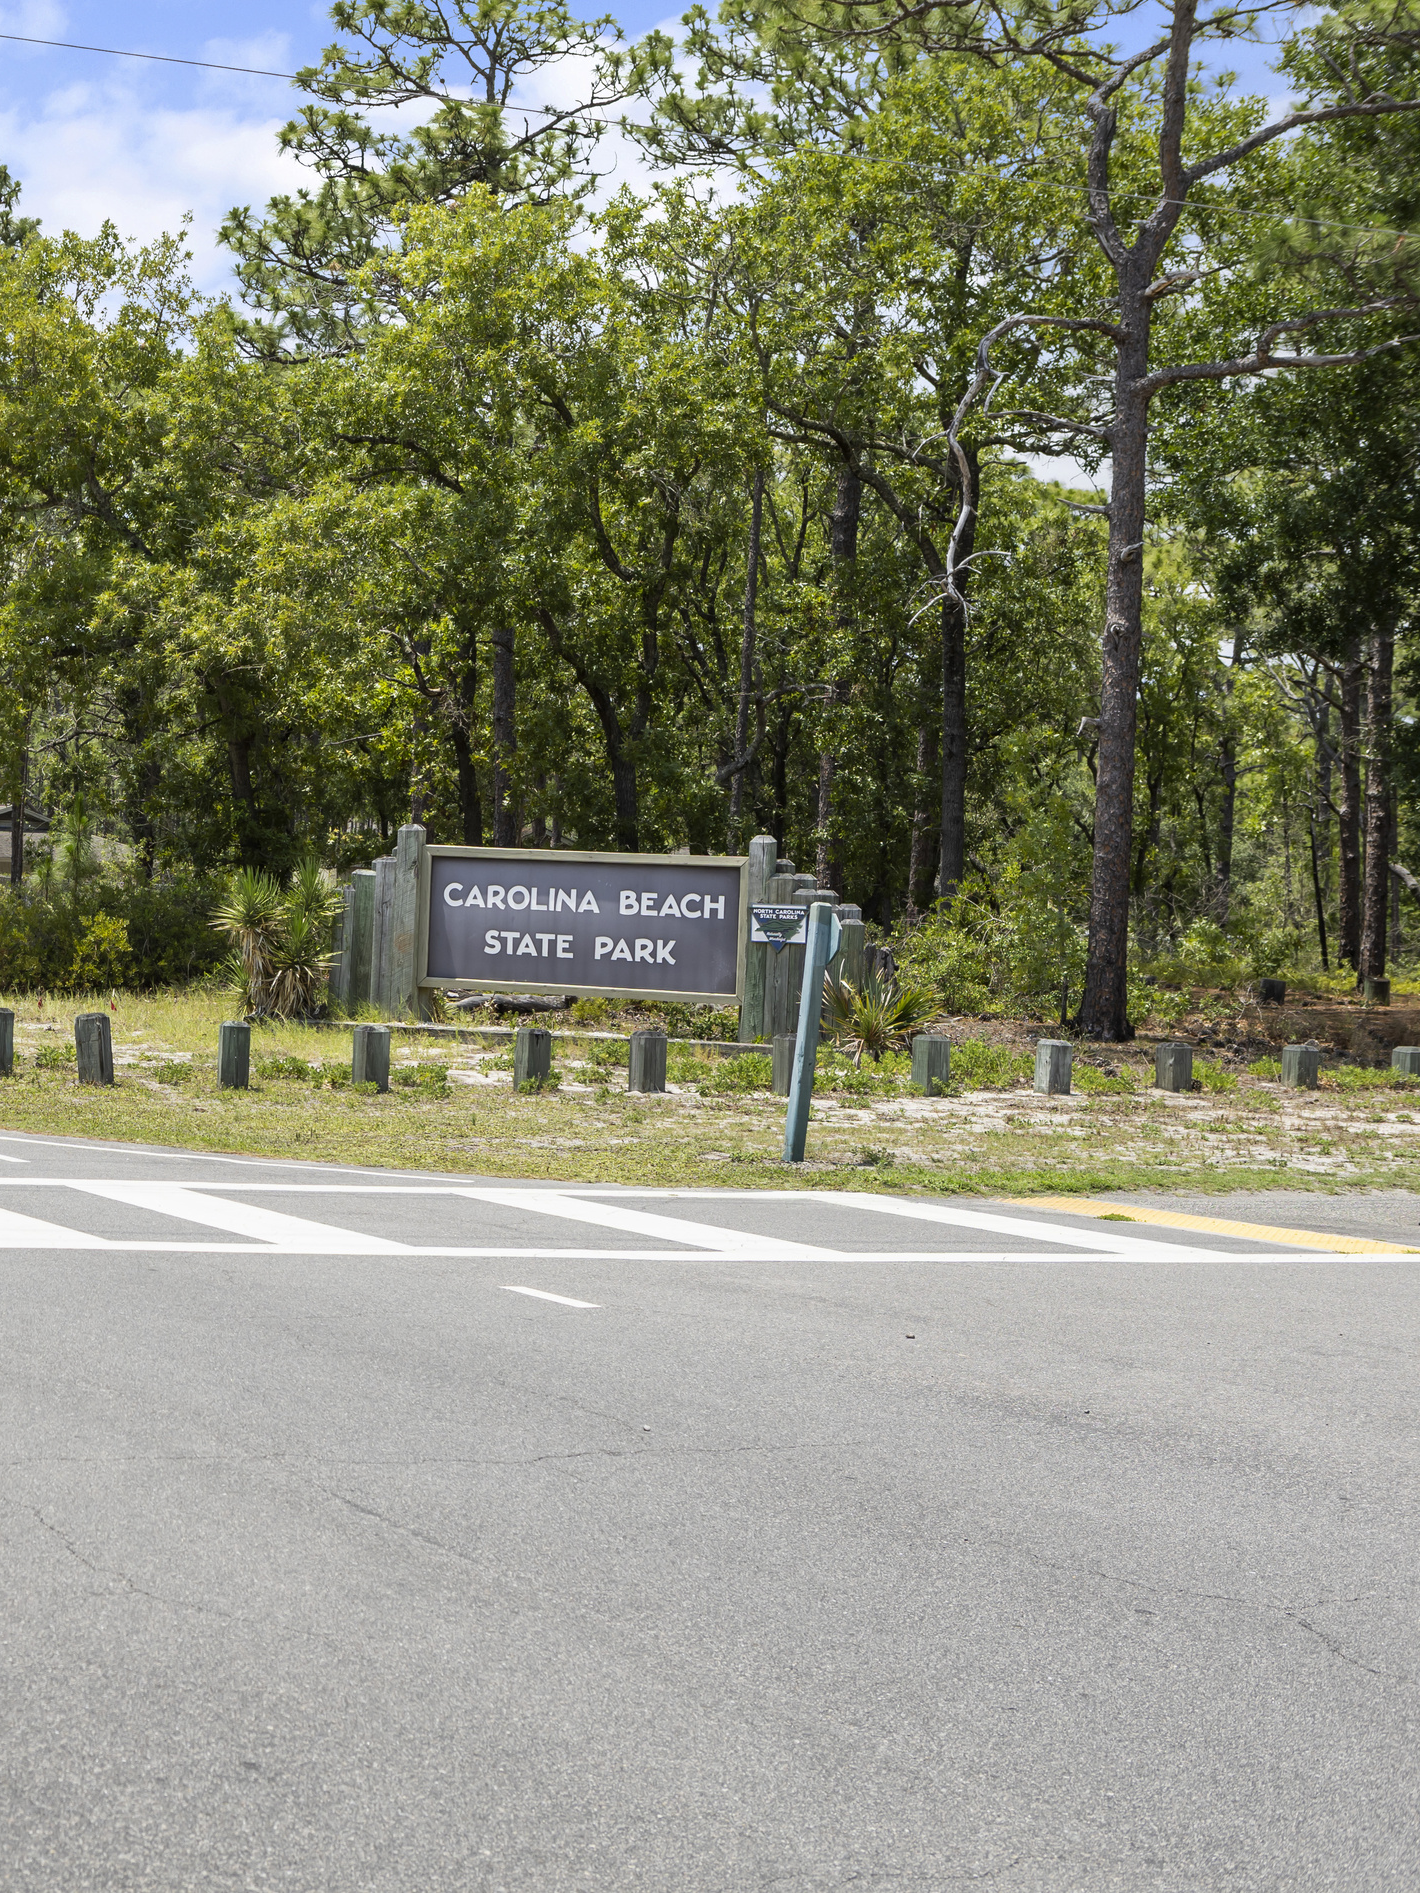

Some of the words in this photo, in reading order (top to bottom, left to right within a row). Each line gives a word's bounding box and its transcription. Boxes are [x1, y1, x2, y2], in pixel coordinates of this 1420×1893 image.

[443, 882, 600, 914] CAROLINA
[619, 889, 726, 919] BEACH
[483, 930, 574, 959] STATE
[594, 936, 677, 966] PARK
